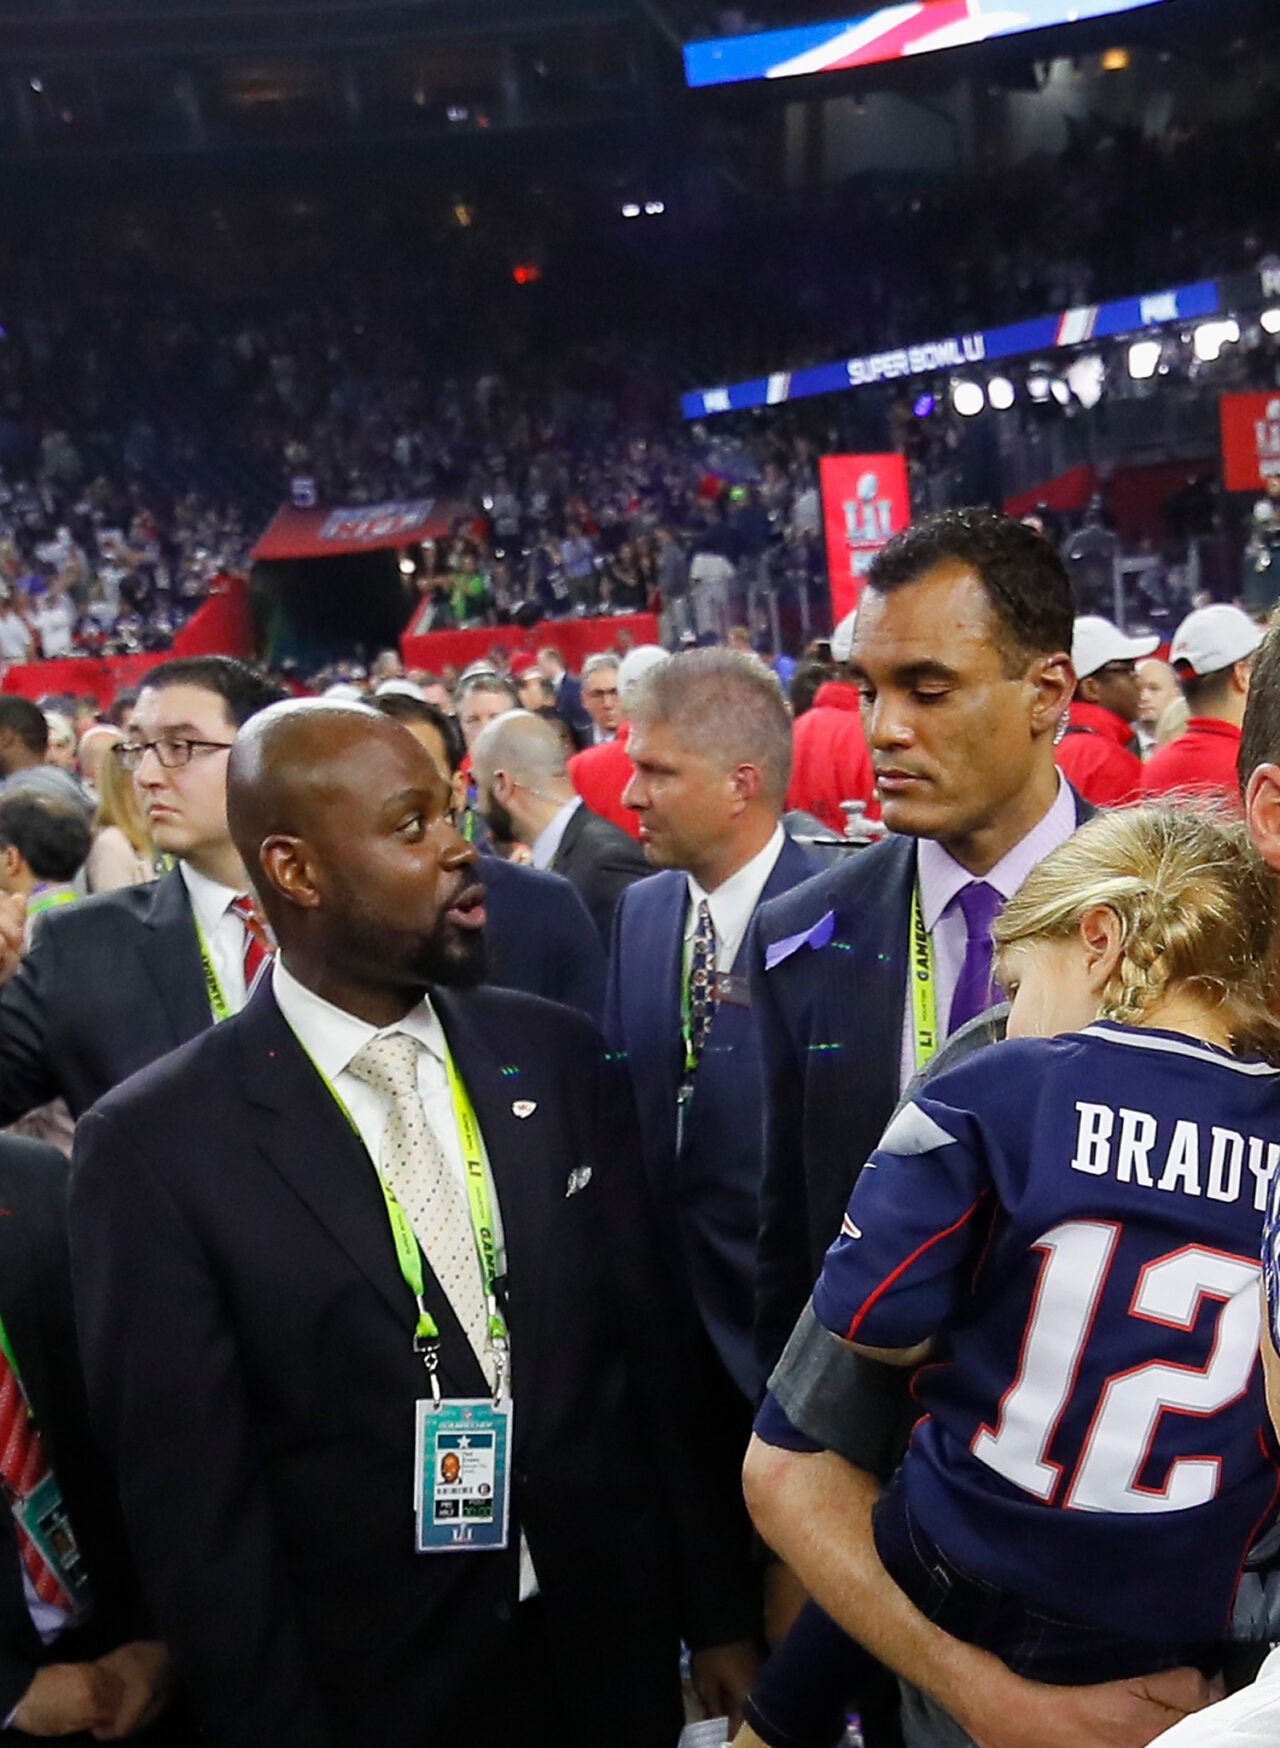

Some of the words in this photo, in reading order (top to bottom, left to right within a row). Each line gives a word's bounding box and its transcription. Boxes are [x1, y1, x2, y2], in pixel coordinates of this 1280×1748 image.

[847, 349, 908, 385] SUPER
[908, 338, 965, 374] BOWL
[919, 1030, 933, 1048] LI
[467, 1159, 482, 1177] LI
[1071, 1101, 1280, 1211] BRADY
[971, 1219, 1261, 1513] 12
